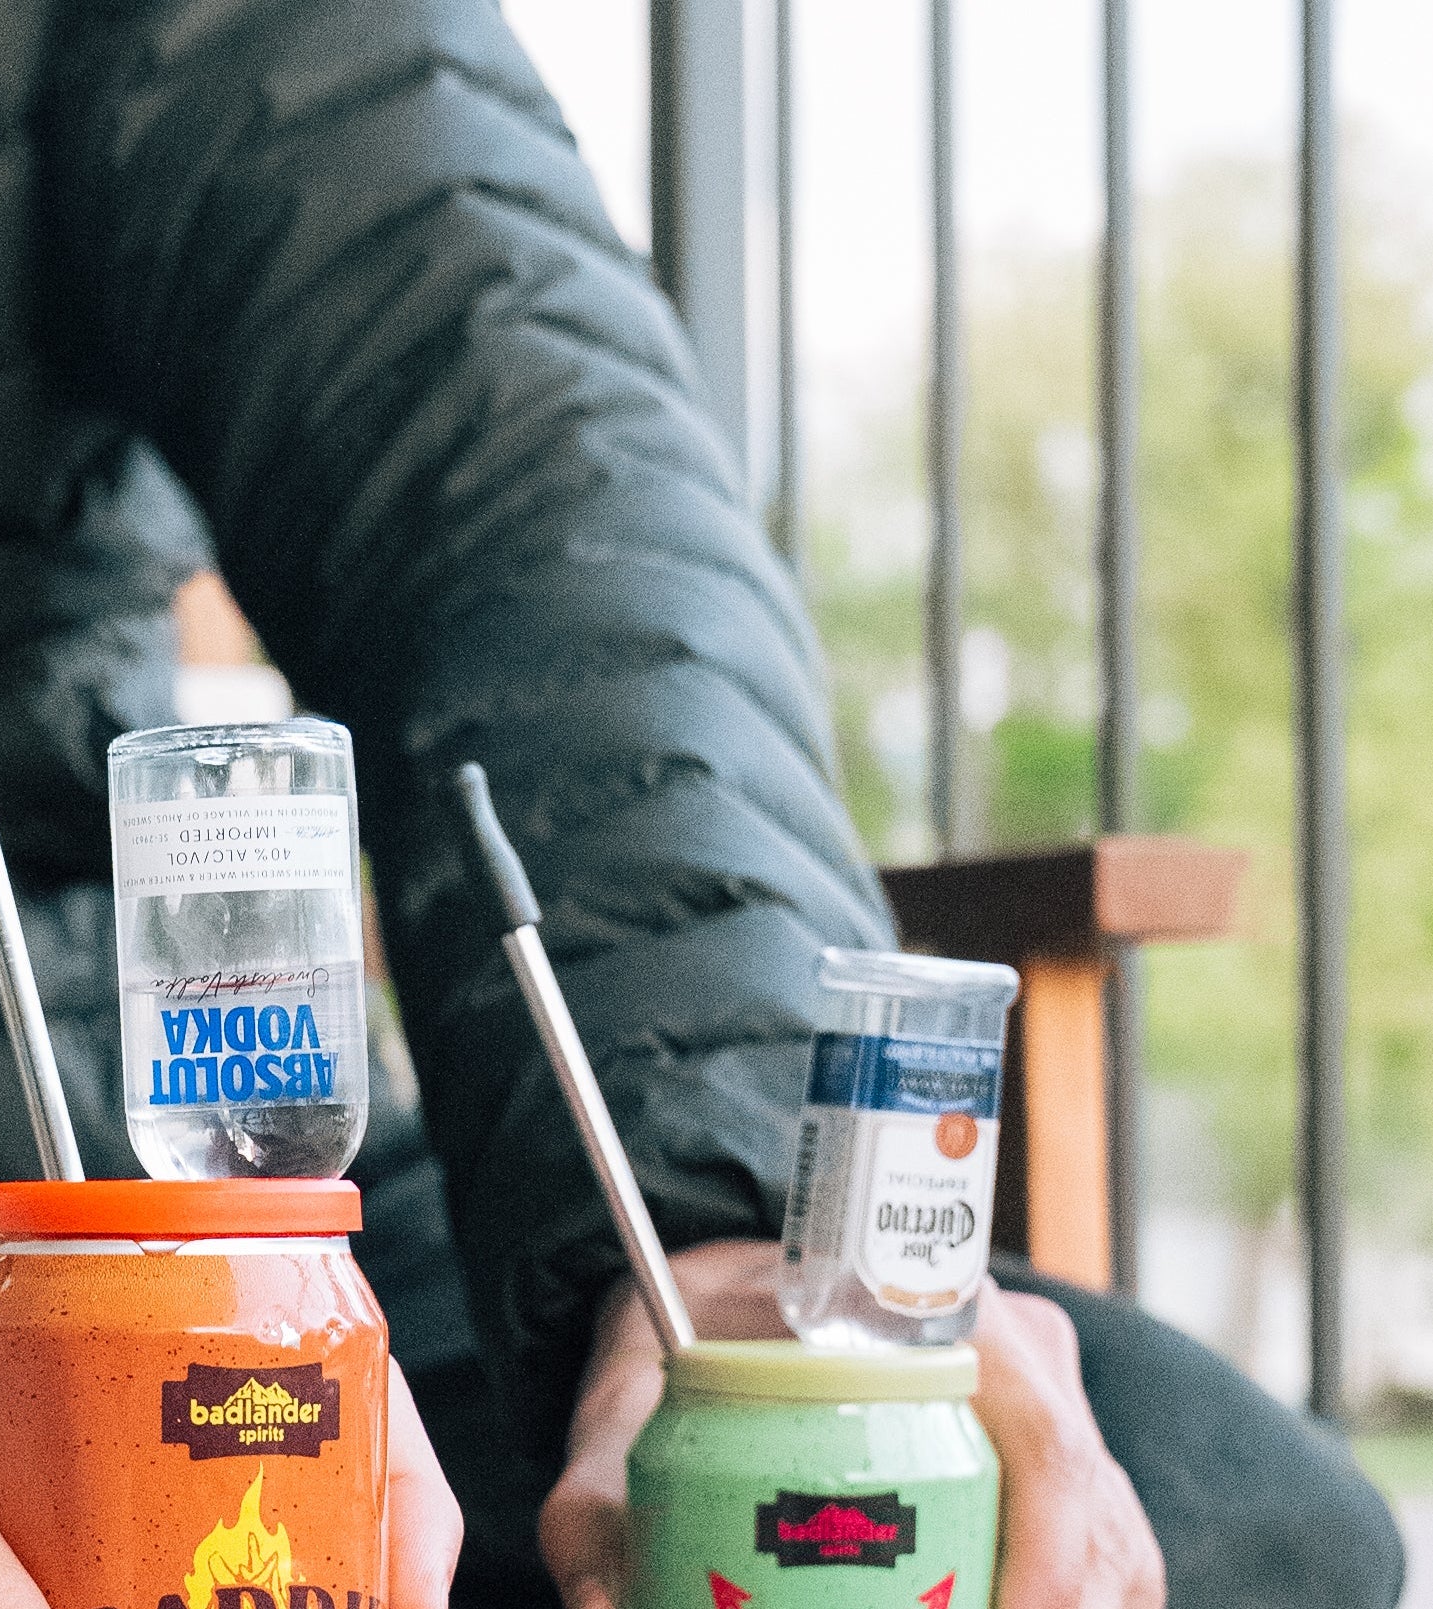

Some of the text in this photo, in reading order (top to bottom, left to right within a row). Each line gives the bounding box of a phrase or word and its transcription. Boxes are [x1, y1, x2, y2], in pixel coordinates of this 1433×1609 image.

[187, 811, 200, 820] OF
[204, 810, 250, 819] VILLAGE
[278, 808, 288, 817] IN
[180, 826, 276, 843] IMPORTED
[167, 847, 291, 867] 40% ALC/VOL
[189, 873, 195, 881] &
[200, 871, 237, 881] WATER
[241, 869, 291, 879] SWEDISH
[294, 869, 320, 878] WITH
[323, 869, 344, 878] MADE
[148, 874, 185, 885] WINTER
[150, 967, 330, 1003] Swedish Vodka
[161, 1004, 321, 1055] VODKA
[149, 1052, 339, 1105] ABSOLUT
[877, 1200, 975, 1248] Cuervo
[190, 1398, 321, 1425] badlander
[238, 1425, 285, 1446] spirits
